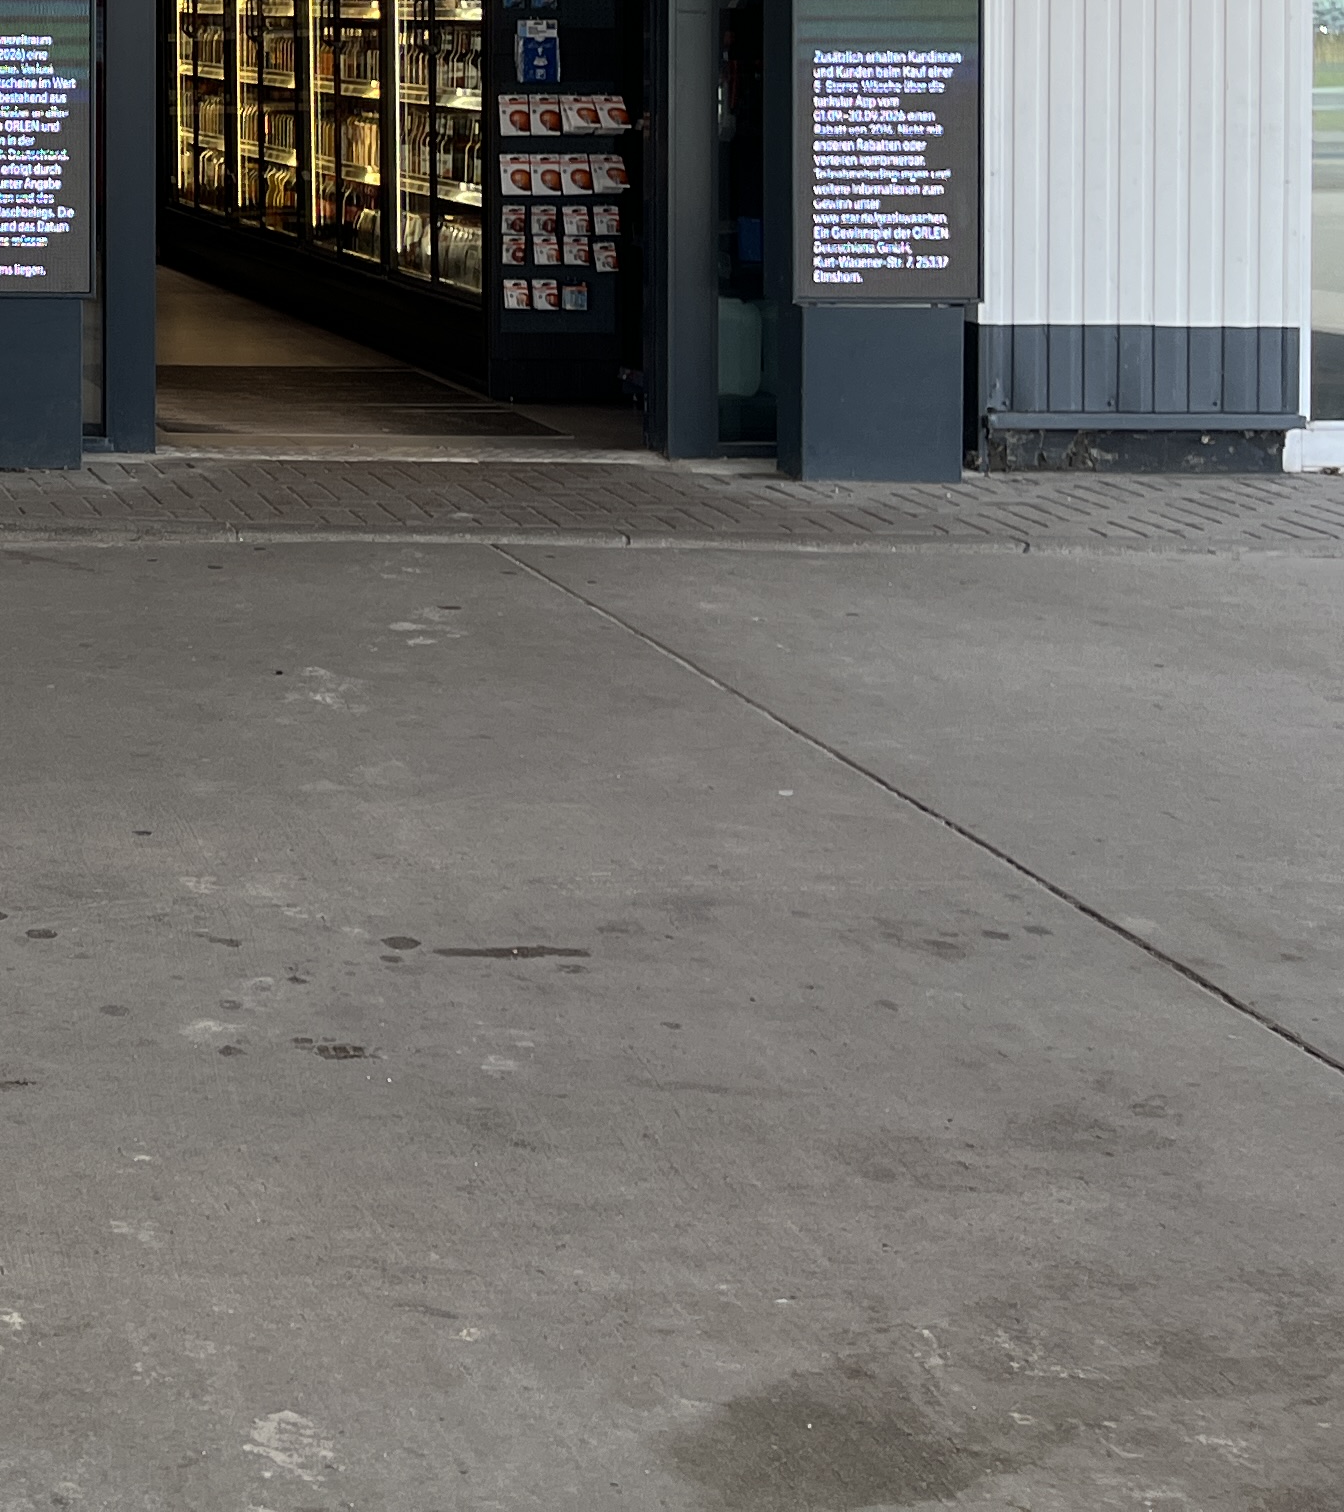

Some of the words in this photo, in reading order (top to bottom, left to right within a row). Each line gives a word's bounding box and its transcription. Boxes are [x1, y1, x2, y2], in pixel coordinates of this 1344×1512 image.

[813, 66, 834, 78] und
[835, 66, 874, 78] Kunden
[39, 77, 51, 89] im
[52, 77, 76, 89] Wert
[50, 91, 67, 104] aus
[5, 120, 39, 132] ORLEN
[41, 120, 60, 132] und
[7, 135, 16, 146] in
[18, 135, 35, 146] der
[1, 162, 32, 176] erfolgt
[33, 162, 62, 176] durch
[24, 177, 61, 190] Angabe
[57, 206, 75, 219] Die
[18, 220, 35, 234] das
[37, 220, 69, 234] Datum
[814, 226, 829, 240] Ein
[831, 226, 891, 240] Gewinnspiel
[894, 226, 910, 240] der
[912, 226, 949, 240] ORLEN
